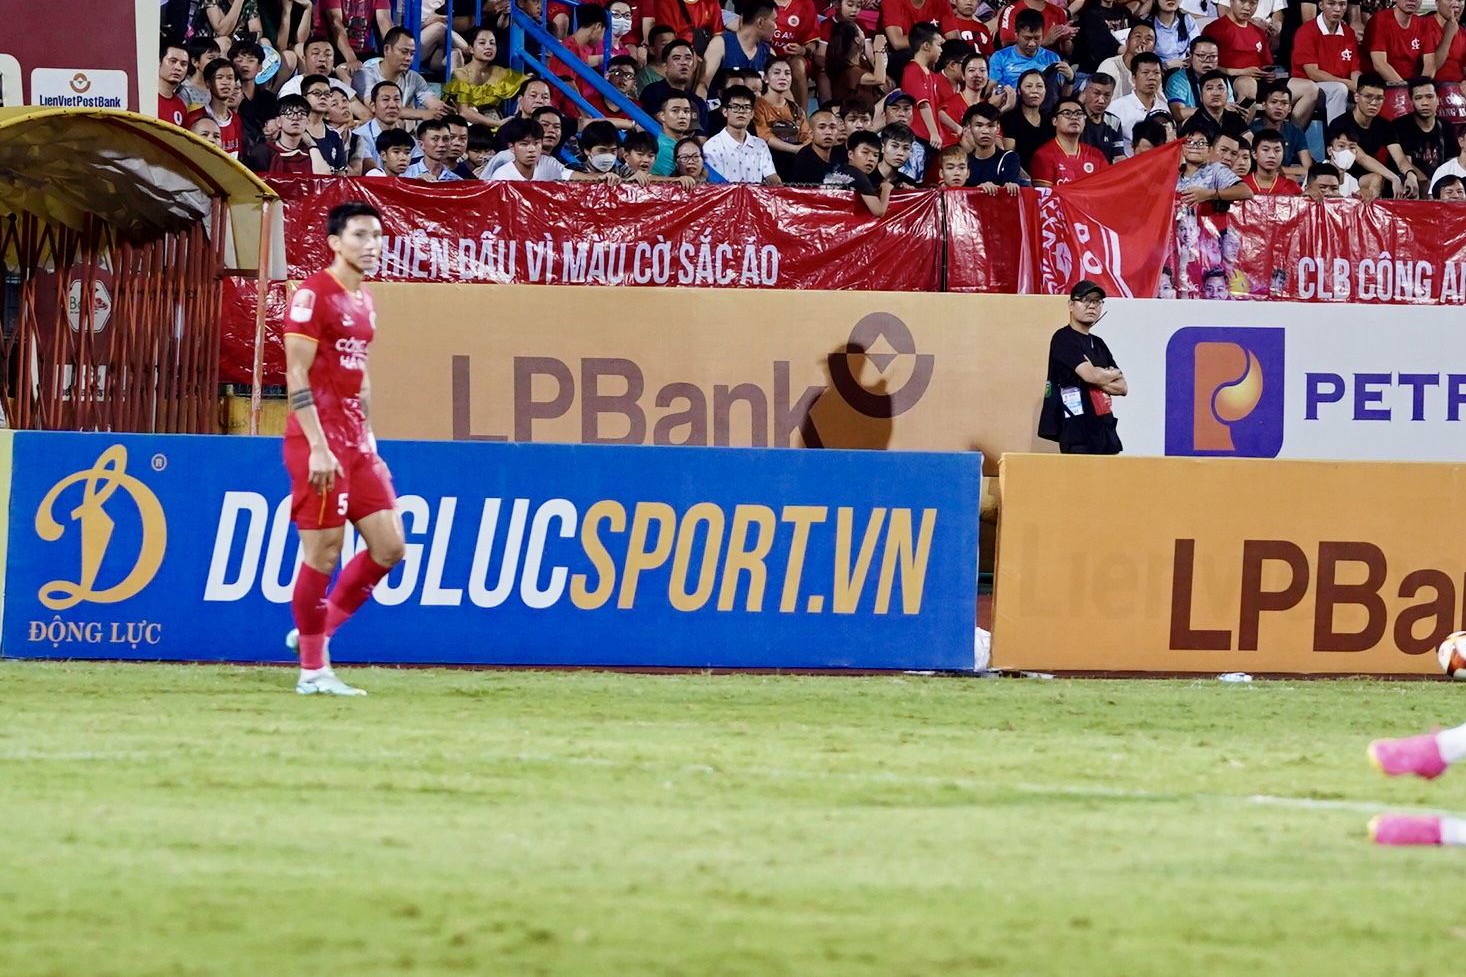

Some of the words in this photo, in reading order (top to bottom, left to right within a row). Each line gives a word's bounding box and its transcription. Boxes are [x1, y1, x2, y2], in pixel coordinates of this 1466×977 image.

[39, 94, 121, 109] LienVietPostBank
[368, 225, 450, 280] HIẾN
[523, 232, 553, 283] VÌ
[634, 234, 672, 284] CỜ
[679, 226, 732, 286] SẮC
[1298, 256, 1350, 300] CLB
[1358, 250, 1433, 302] CÔNG
[337, 492, 349, 516] 5
[204, 490, 937, 615] DOGLUCSPORT.VN
[28, 615, 103, 645] ĐỘNG
[110, 620, 161, 646] LỰC
